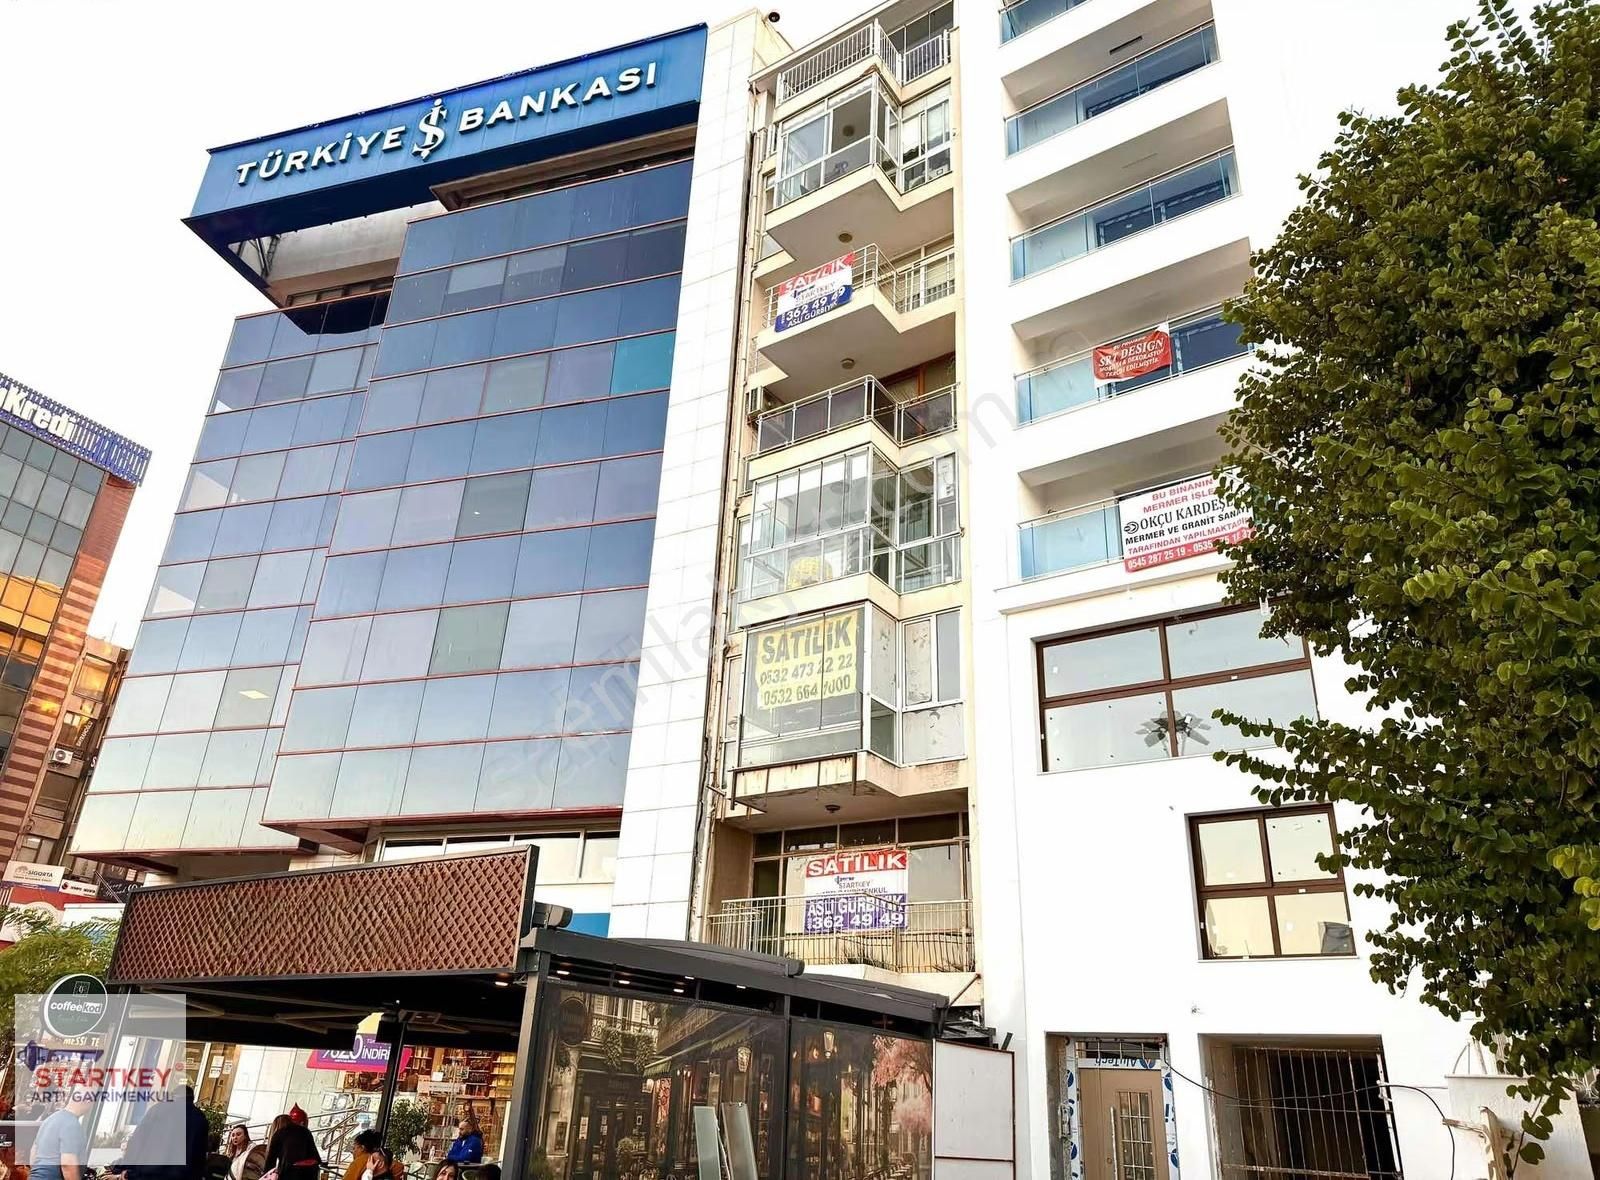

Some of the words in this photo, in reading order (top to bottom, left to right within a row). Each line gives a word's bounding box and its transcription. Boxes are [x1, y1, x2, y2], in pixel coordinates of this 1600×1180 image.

[236, 124, 405, 185] TÜRKİYE
[457, 61, 659, 133] BANKASI
[784, 256, 847, 291] SATILIK
[786, 304, 809, 320] 362
[812, 296, 828, 310] 49
[1120, 338, 1164, 360] DESIGN
[1152, 491, 1166, 501] BU
[1169, 478, 1214, 496] BİNANIN
[1143, 497, 1189, 513] MERMER
[1125, 530, 1166, 545] MERMER
[1167, 526, 1179, 535] VE
[1181, 516, 1215, 531] GRANİT
[1140, 512, 1173, 530] OKÇU
[1127, 537, 1181, 555] TARAFINDAN
[1127, 557, 1146, 569] 0545
[1149, 554, 1162, 565] 287
[1164, 550, 1174, 560] 25
[1177, 546, 1186, 556] 19
[761, 615, 852, 664] SATILIK
[760, 667, 789, 686] 0532
[791, 662, 815, 680] 473
[838, 653, 853, 671] 22
[763, 687, 792, 706] 0532
[796, 683, 818, 701] 664
[808, 853, 906, 877] SATILIK
[812, 914, 844, 930] 362
[850, 913, 873, 926] 49
[880, 911, 904, 925] 49
[361, 1046, 391, 1061] İNDİRİ
[1095, 1057, 1137, 1067] AluTech
